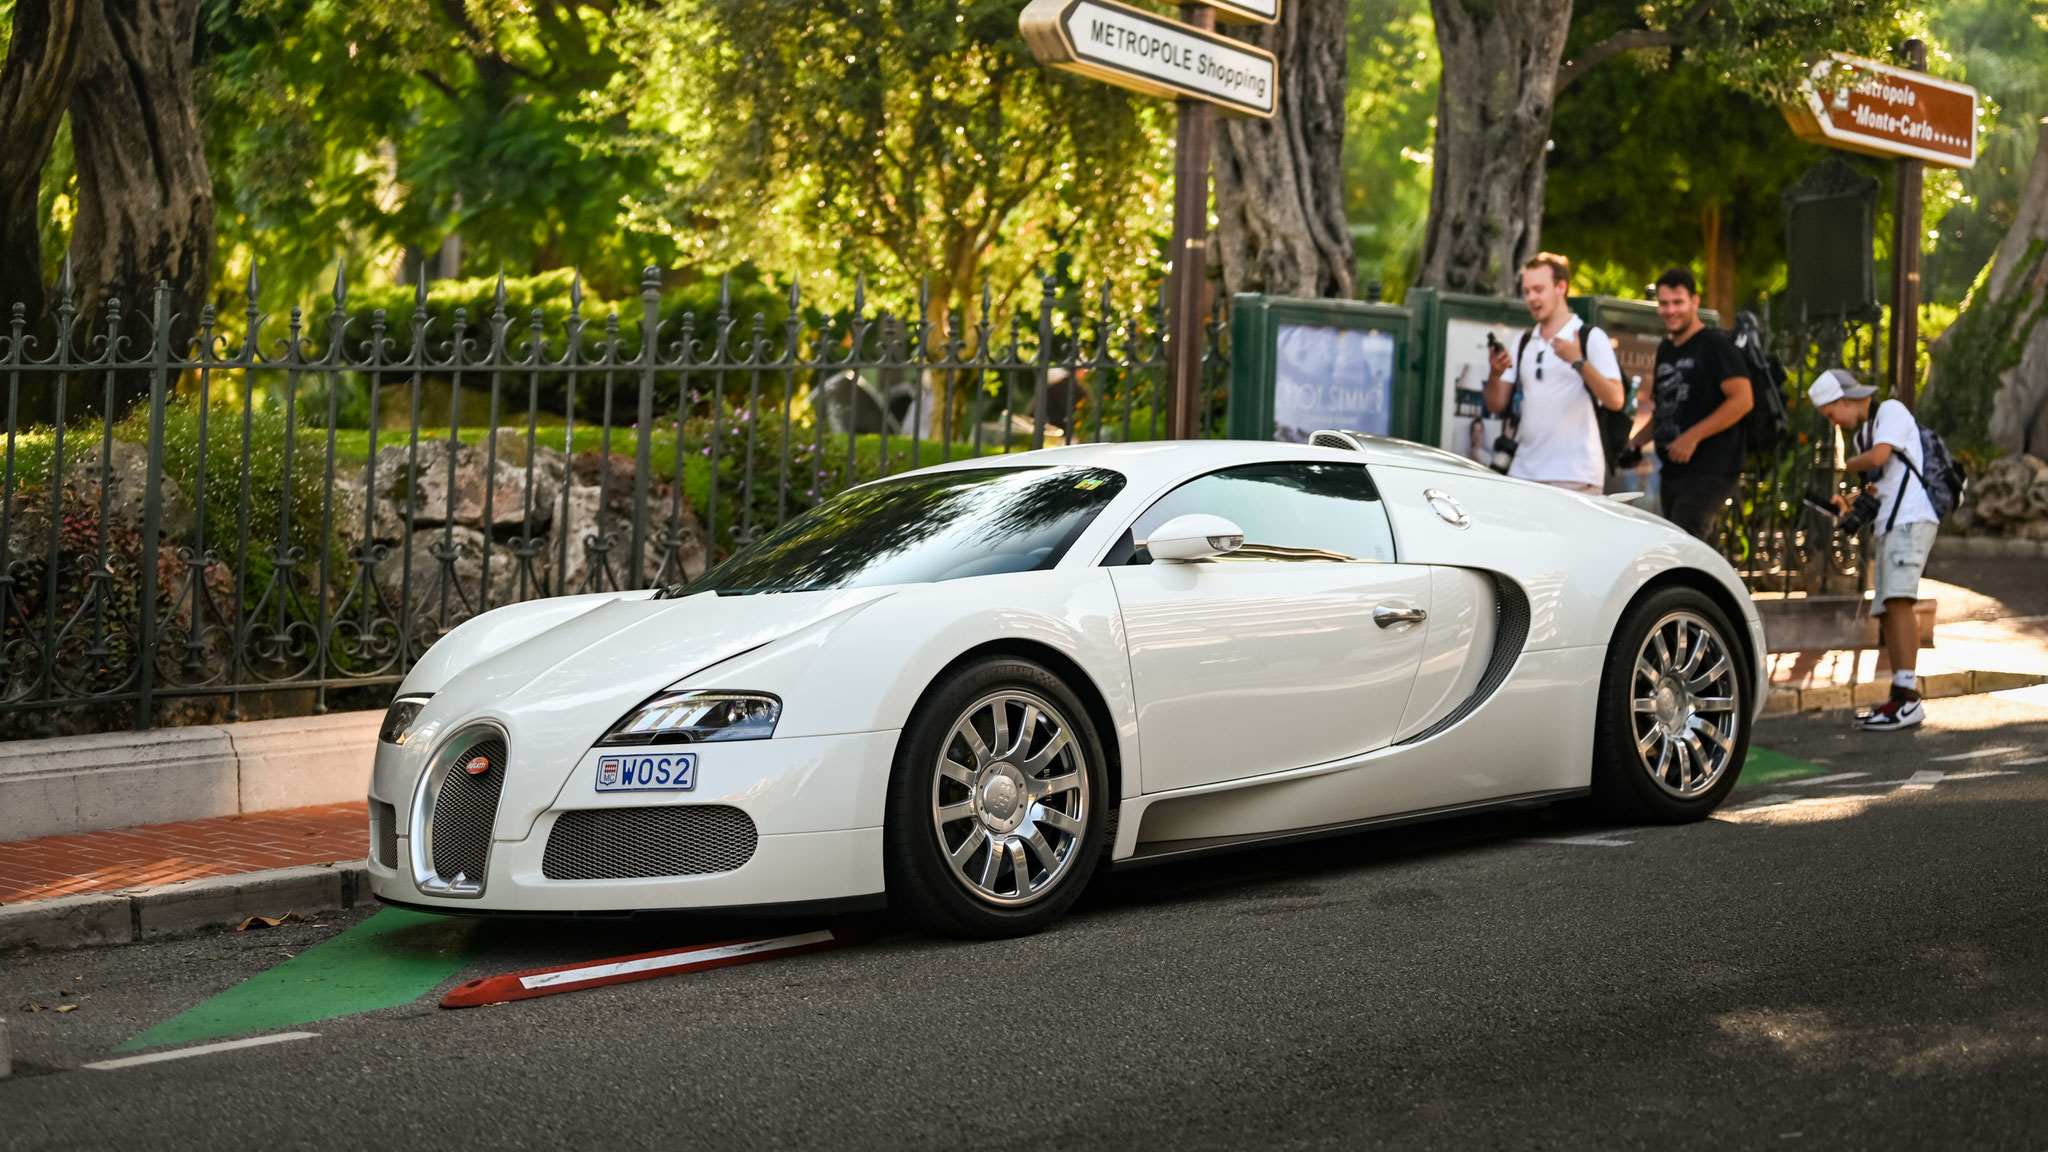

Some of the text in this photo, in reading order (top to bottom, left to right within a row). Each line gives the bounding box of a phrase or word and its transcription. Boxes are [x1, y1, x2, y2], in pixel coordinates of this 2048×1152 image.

[1091, 19, 1266, 98] METROPOLE Shopping
[603, 773, 615, 782] MC
